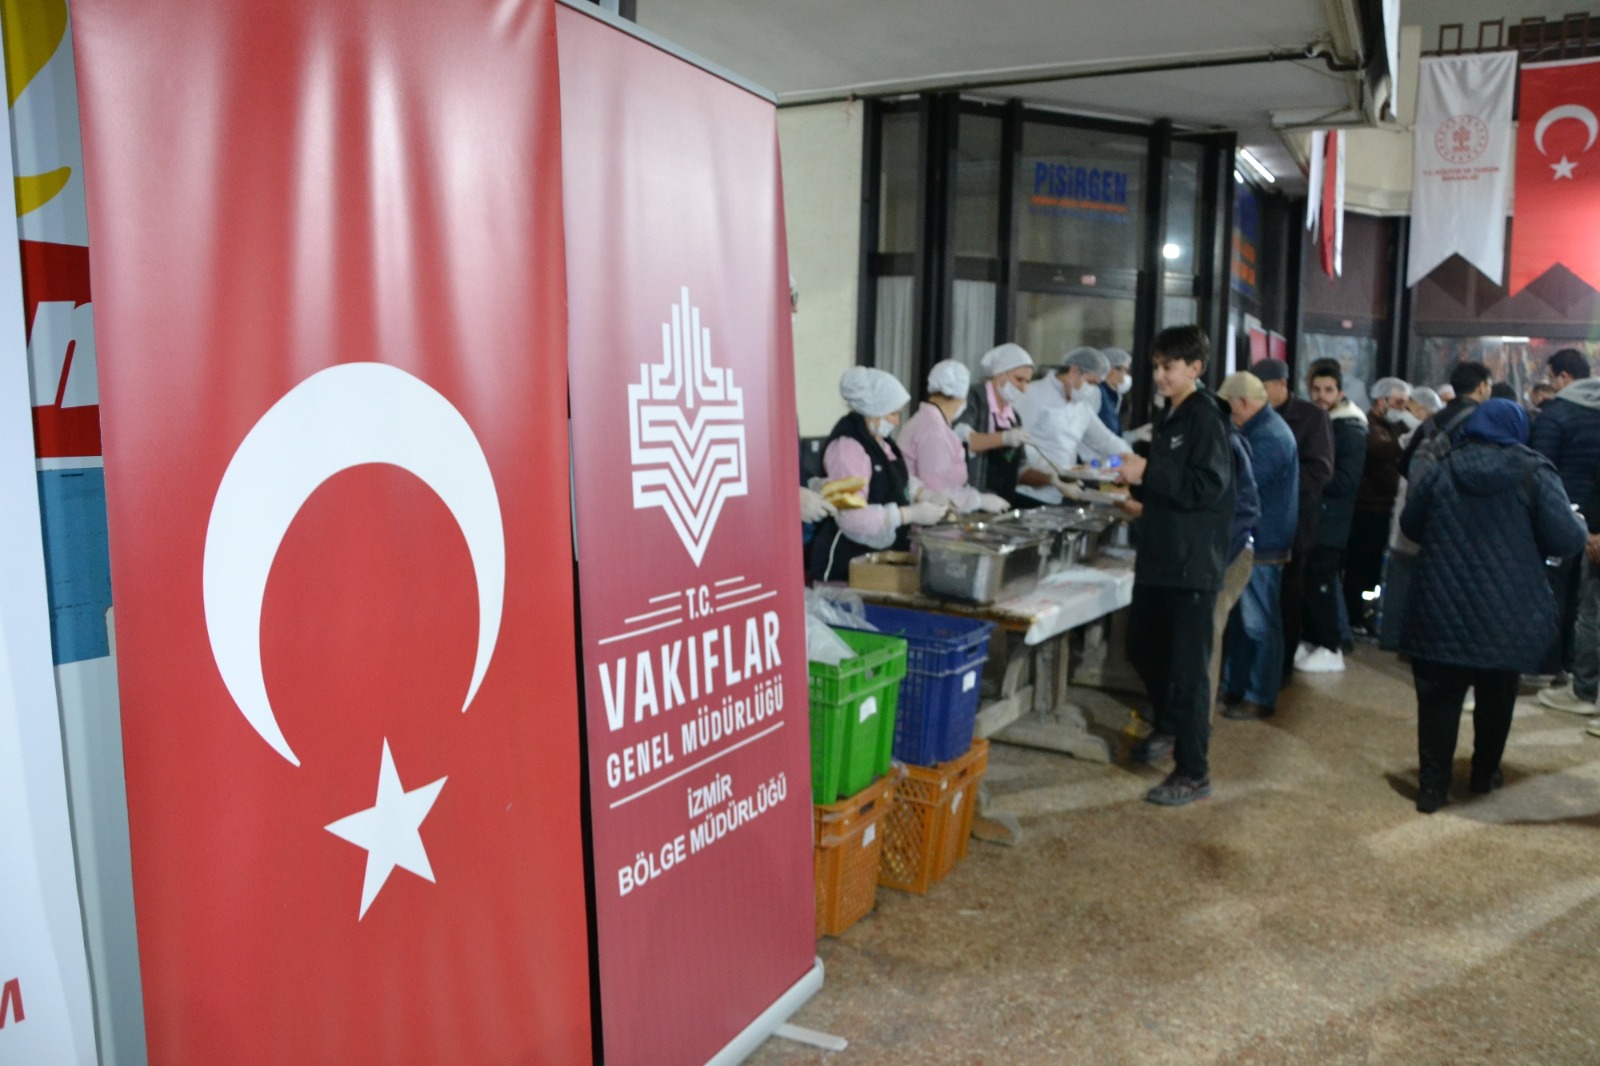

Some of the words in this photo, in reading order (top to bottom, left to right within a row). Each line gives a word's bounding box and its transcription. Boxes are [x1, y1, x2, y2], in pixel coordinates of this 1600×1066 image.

[686, 584, 714, 620] T.C.
[598, 610, 782, 732] VAKIFLAR
[606, 731, 675, 789] GENEL
[681, 674, 784, 756] MÜDÜRLÜĞÜ
[618, 834, 687, 897] BÖLGE
[690, 772, 787, 854] MÜDÜRLÜĞÜ
[687, 773, 733, 819] İZMİR
